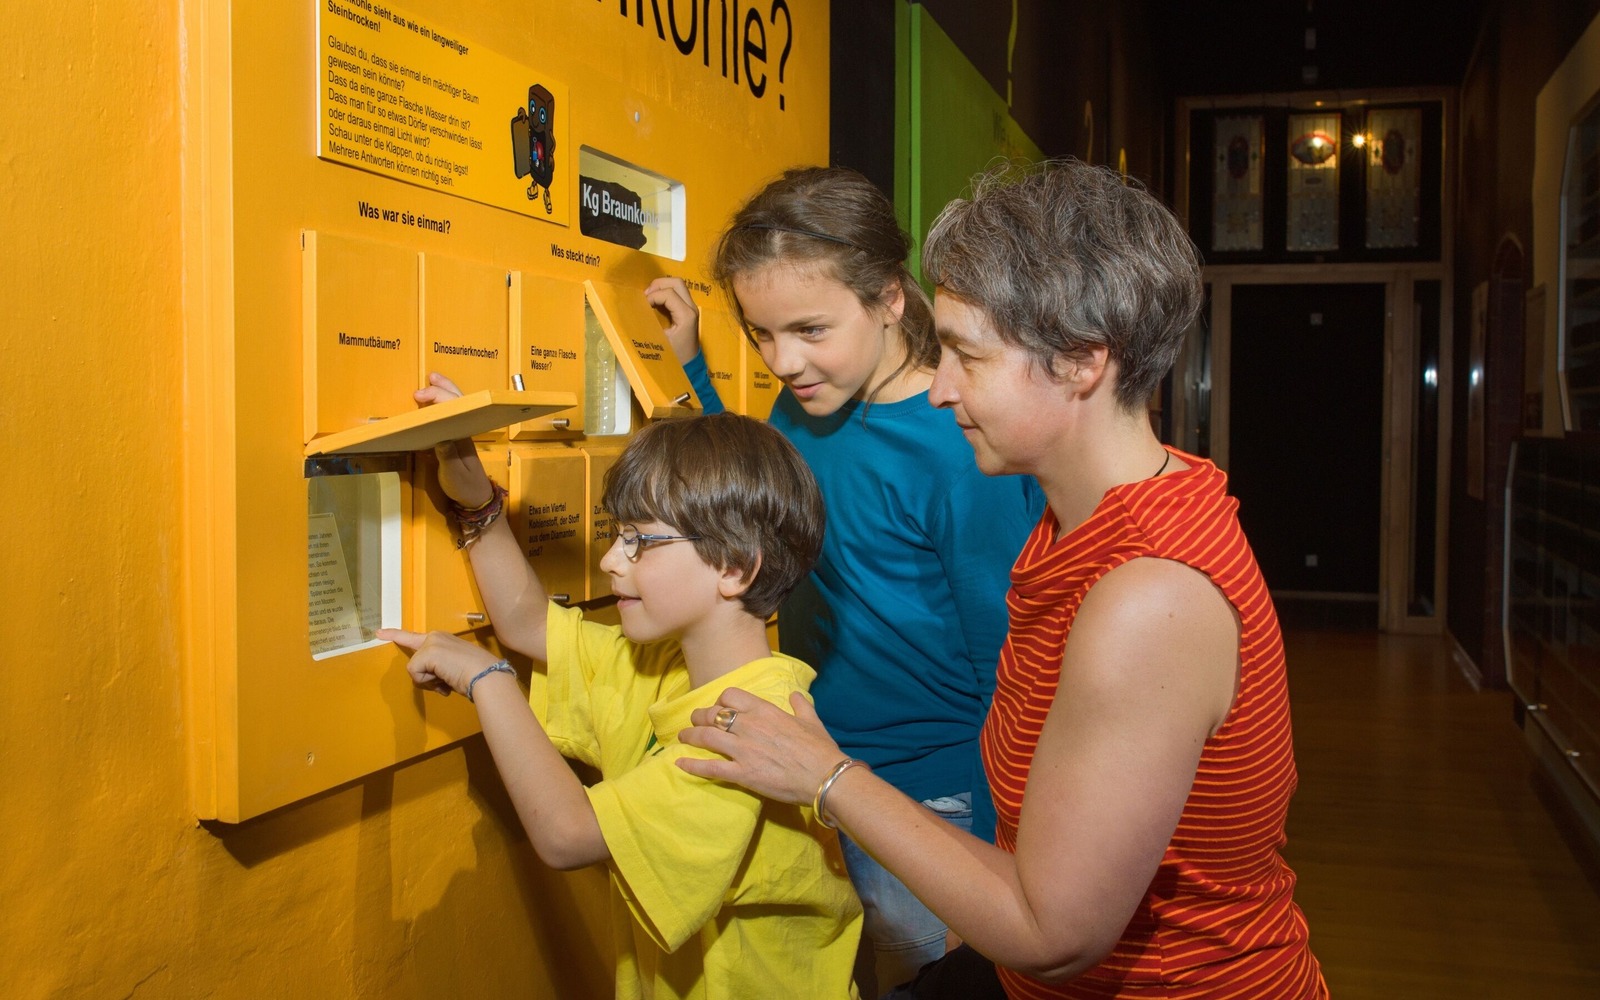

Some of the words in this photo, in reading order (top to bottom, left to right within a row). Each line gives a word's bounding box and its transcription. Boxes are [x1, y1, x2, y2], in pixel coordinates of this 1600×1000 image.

[327, 0, 381, 33] Steinbrocken!
[373, 4, 391, 21] sieht
[393, 14, 406, 27] aus
[407, 20, 419, 33] wie
[420, 25, 431, 39] ein
[431, 29, 469, 56] langweiliger
[327, 35, 357, 57] Glaubst
[358, 47, 370, 63] du,
[371, 53, 388, 69] dass
[388, 60, 399, 73] sie
[400, 65, 422, 81] einmal
[422, 73, 432, 86] ein
[432, 78, 462, 98] mächtiger
[462, 88, 480, 104] Baum
[327, 55, 361, 76] gewesen
[362, 68, 378, 82] sein
[378, 72, 405, 92] könnte?
[328, 70, 348, 88] Dass
[349, 78, 359, 92] da
[360, 83, 376, 98] eine
[376, 90, 398, 105] ganze
[399, 95, 424, 115] Flasche
[424, 104, 447, 123] Wasser
[448, 114, 460, 128] drin
[460, 118, 471, 131] ist?
[328, 87, 348, 105] Dass
[349, 97, 366, 111] man
[366, 100, 377, 115] für
[377, 107, 387, 118] so
[387, 110, 407, 125] etwas
[408, 115, 428, 132] Dörfer
[429, 124, 469, 146] verschwinden
[469, 136, 483, 151] lässt
[328, 107, 346, 122] oder
[347, 112, 372, 130] daraus
[373, 121, 396, 137] einmal
[397, 127, 413, 143] Licht
[413, 134, 431, 148] wird?
[328, 123, 353, 141] Schau
[354, 133, 373, 147] unter
[373, 137, 385, 150] die
[385, 141, 415, 161] Klappen,
[415, 150, 424, 163] ob
[425, 153, 433, 165] du
[434, 156, 452, 173] richtig
[328, 140, 360, 160] Mehrere
[360, 150, 395, 170] Antworten
[396, 160, 420, 176] können
[420, 167, 440, 185] richtig
[440, 175, 455, 187] sein.
[583, 183, 599, 217] Kg
[358, 200, 380, 220] Was
[382, 208, 399, 223] war
[401, 210, 415, 226] sie
[417, 214, 451, 235] einmal?
[551, 243, 565, 259] Was
[565, 248, 585, 264] steckt
[585, 252, 601, 268] drin?
[338, 332, 401, 350] Mammutbäume?
[433, 341, 499, 360] Dinosaurierknochen?
[530, 345, 542, 357] Eine
[542, 349, 558, 360] ganze
[558, 348, 577, 360] Flasche
[530, 359, 553, 371] Wasser?
[529, 505, 542, 516] Etwa
[542, 504, 551, 514] ein
[551, 502, 567, 513] Viertel
[560, 515, 568, 525] der
[568, 513, 580, 525] Stoff
[550, 529, 577, 541] Diamanten
